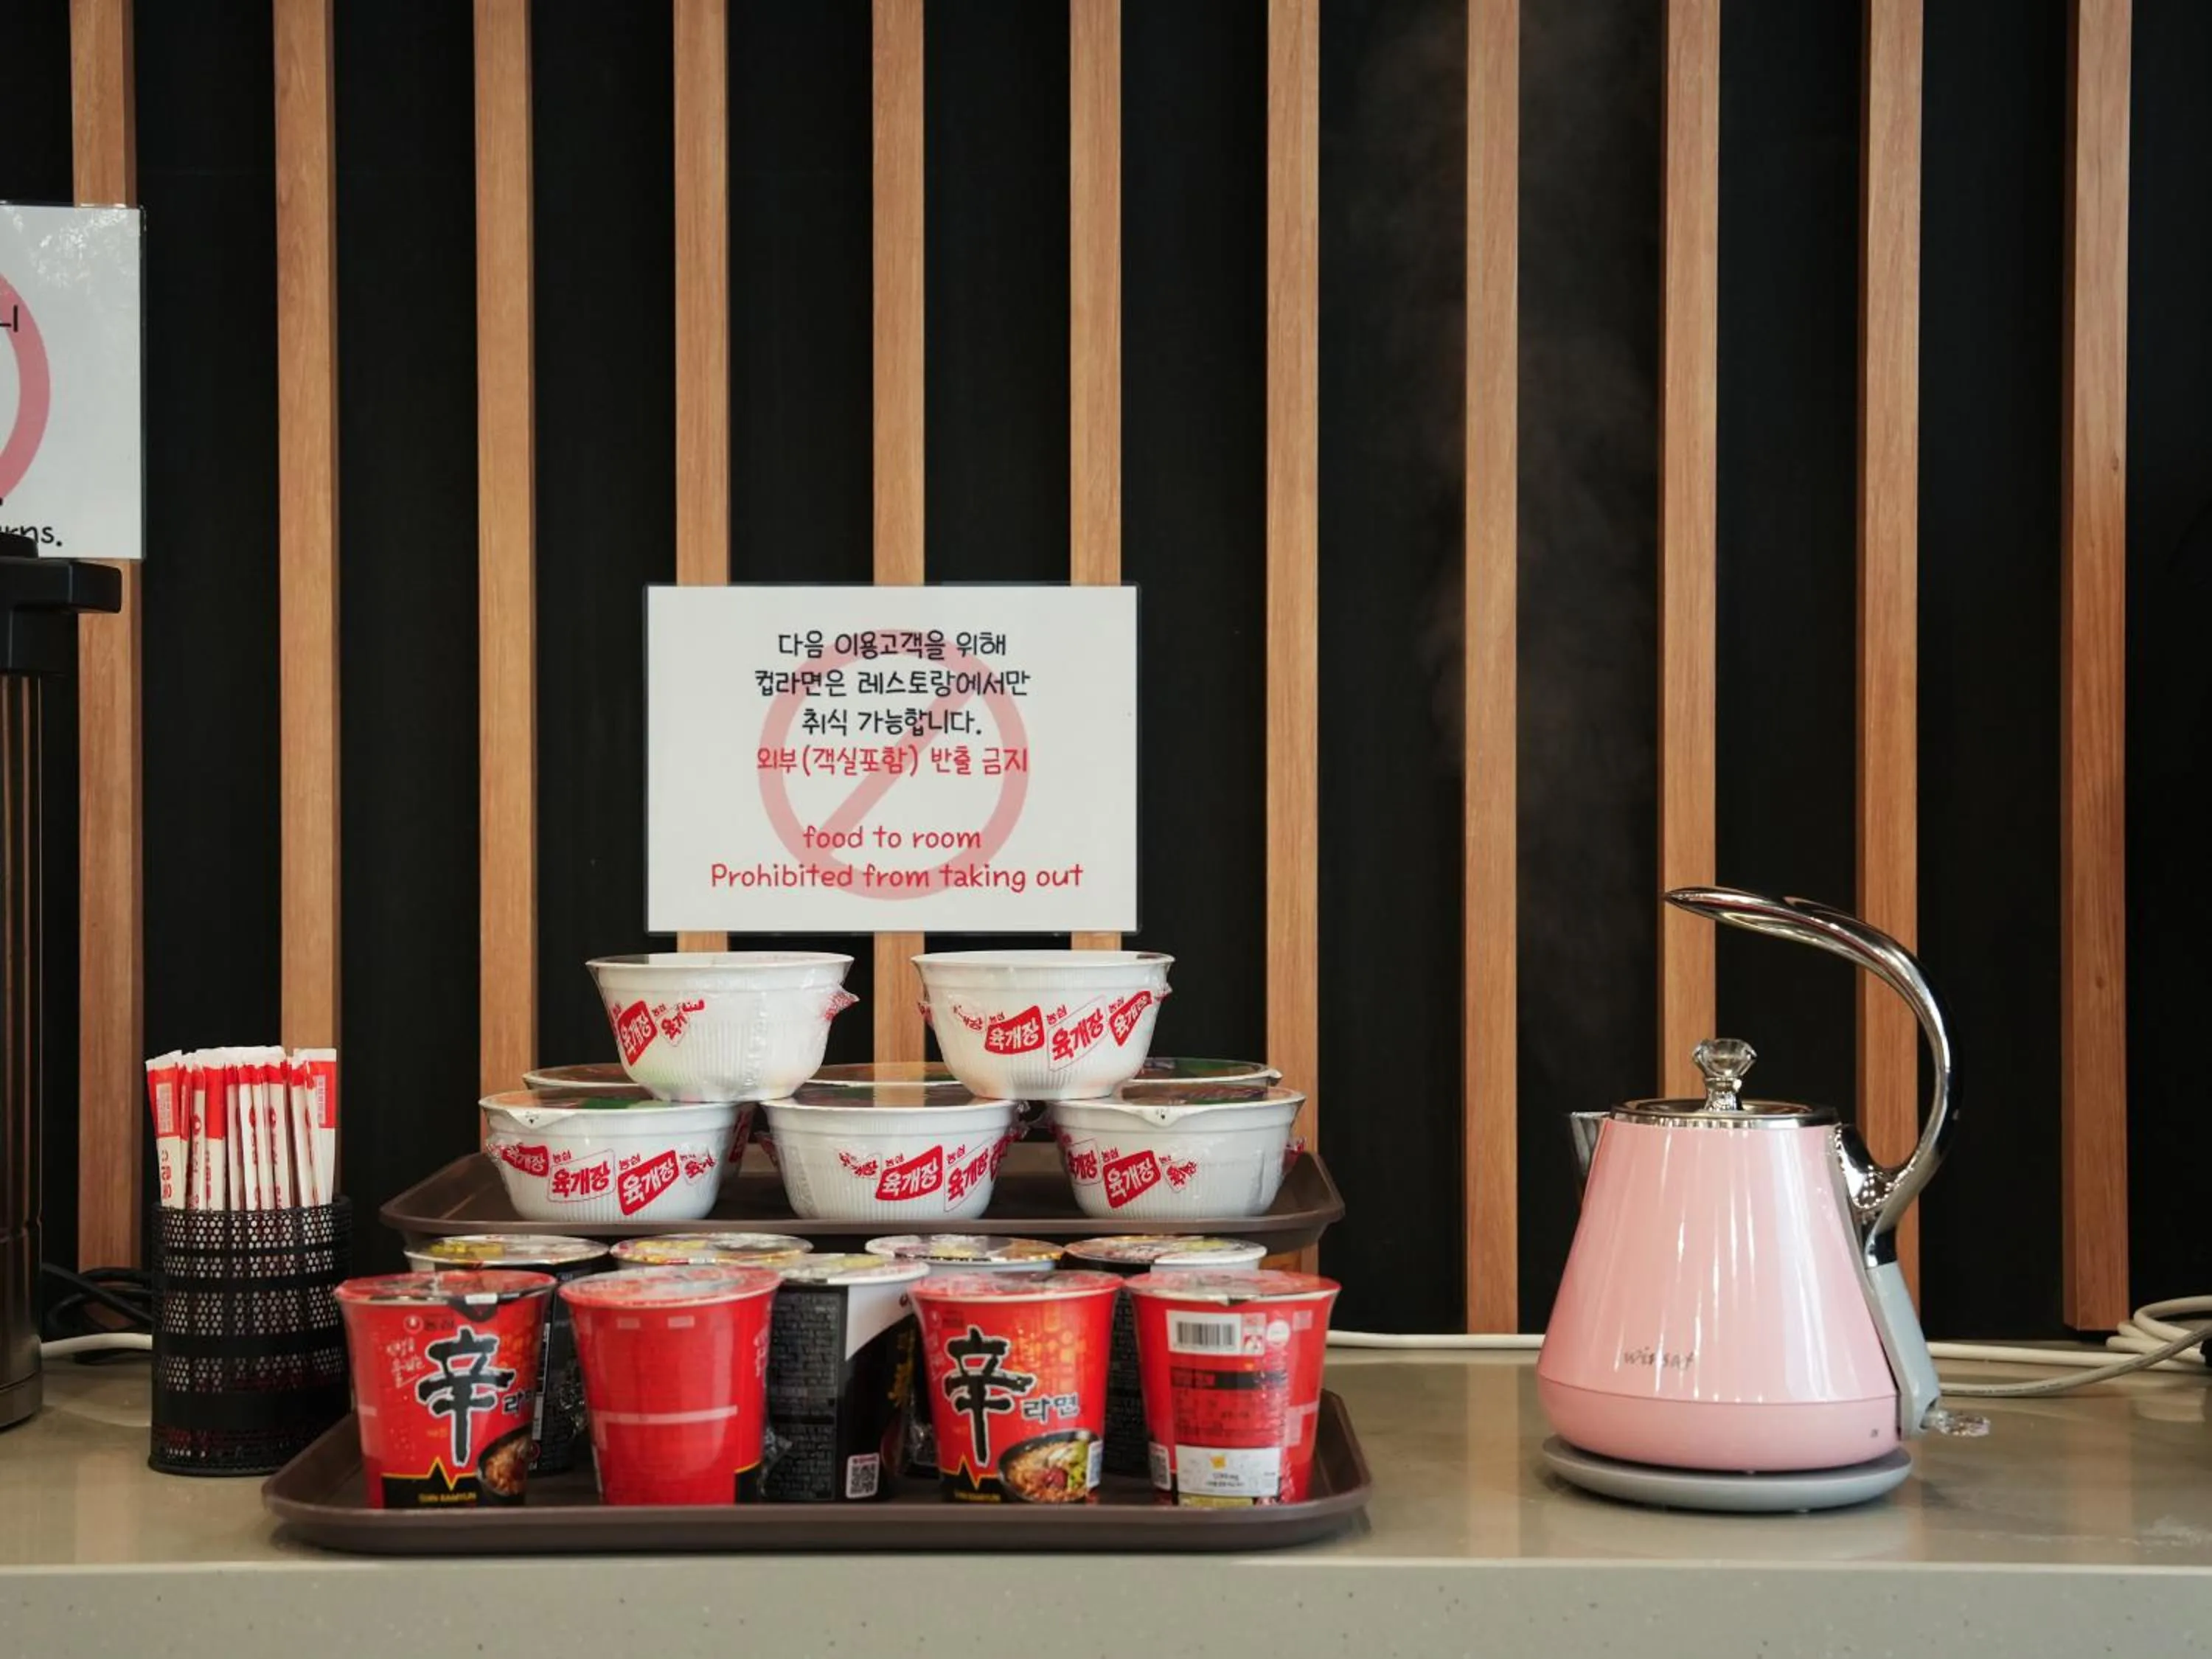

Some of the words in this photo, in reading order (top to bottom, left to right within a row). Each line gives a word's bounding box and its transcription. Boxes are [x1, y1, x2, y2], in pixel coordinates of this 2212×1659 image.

[778, 630, 824, 658] 다음
[835, 629, 946, 661] 이용고객을
[956, 632, 1006, 658] 위해
[754, 669, 846, 697] 컵라면은
[858, 670, 1031, 698] 레스토랑에서만
[801, 708, 847, 737] 취식
[858, 707, 982, 737] 가능합니다.
[757, 745, 919, 776] 외부(객실포함)
[931, 746, 971, 775] 반출
[983, 747, 1028, 774] 금지
[802, 825, 863, 849] food
[873, 825, 901, 849] to
[914, 832, 982, 849] room
[712, 863, 853, 888] Prohibited
[863, 863, 931, 888] from
[938, 863, 1026, 894] taking
[1037, 864, 1083, 887] out
[988, 1017, 1039, 1051] 육개장
[1052, 1007, 1104, 1060] 육개장
[552, 1160, 611, 1198] 육개장
[622, 1157, 675, 1206] 육개장
[881, 1156, 938, 1197] 육개장
[947, 1148, 989, 1202] 육개장
[1108, 1157, 1154, 1198] 육개장
[417, 1326, 516, 1467] 辛
[942, 1326, 1037, 1467] 辛
[1023, 1393, 1079, 1422] 라면
